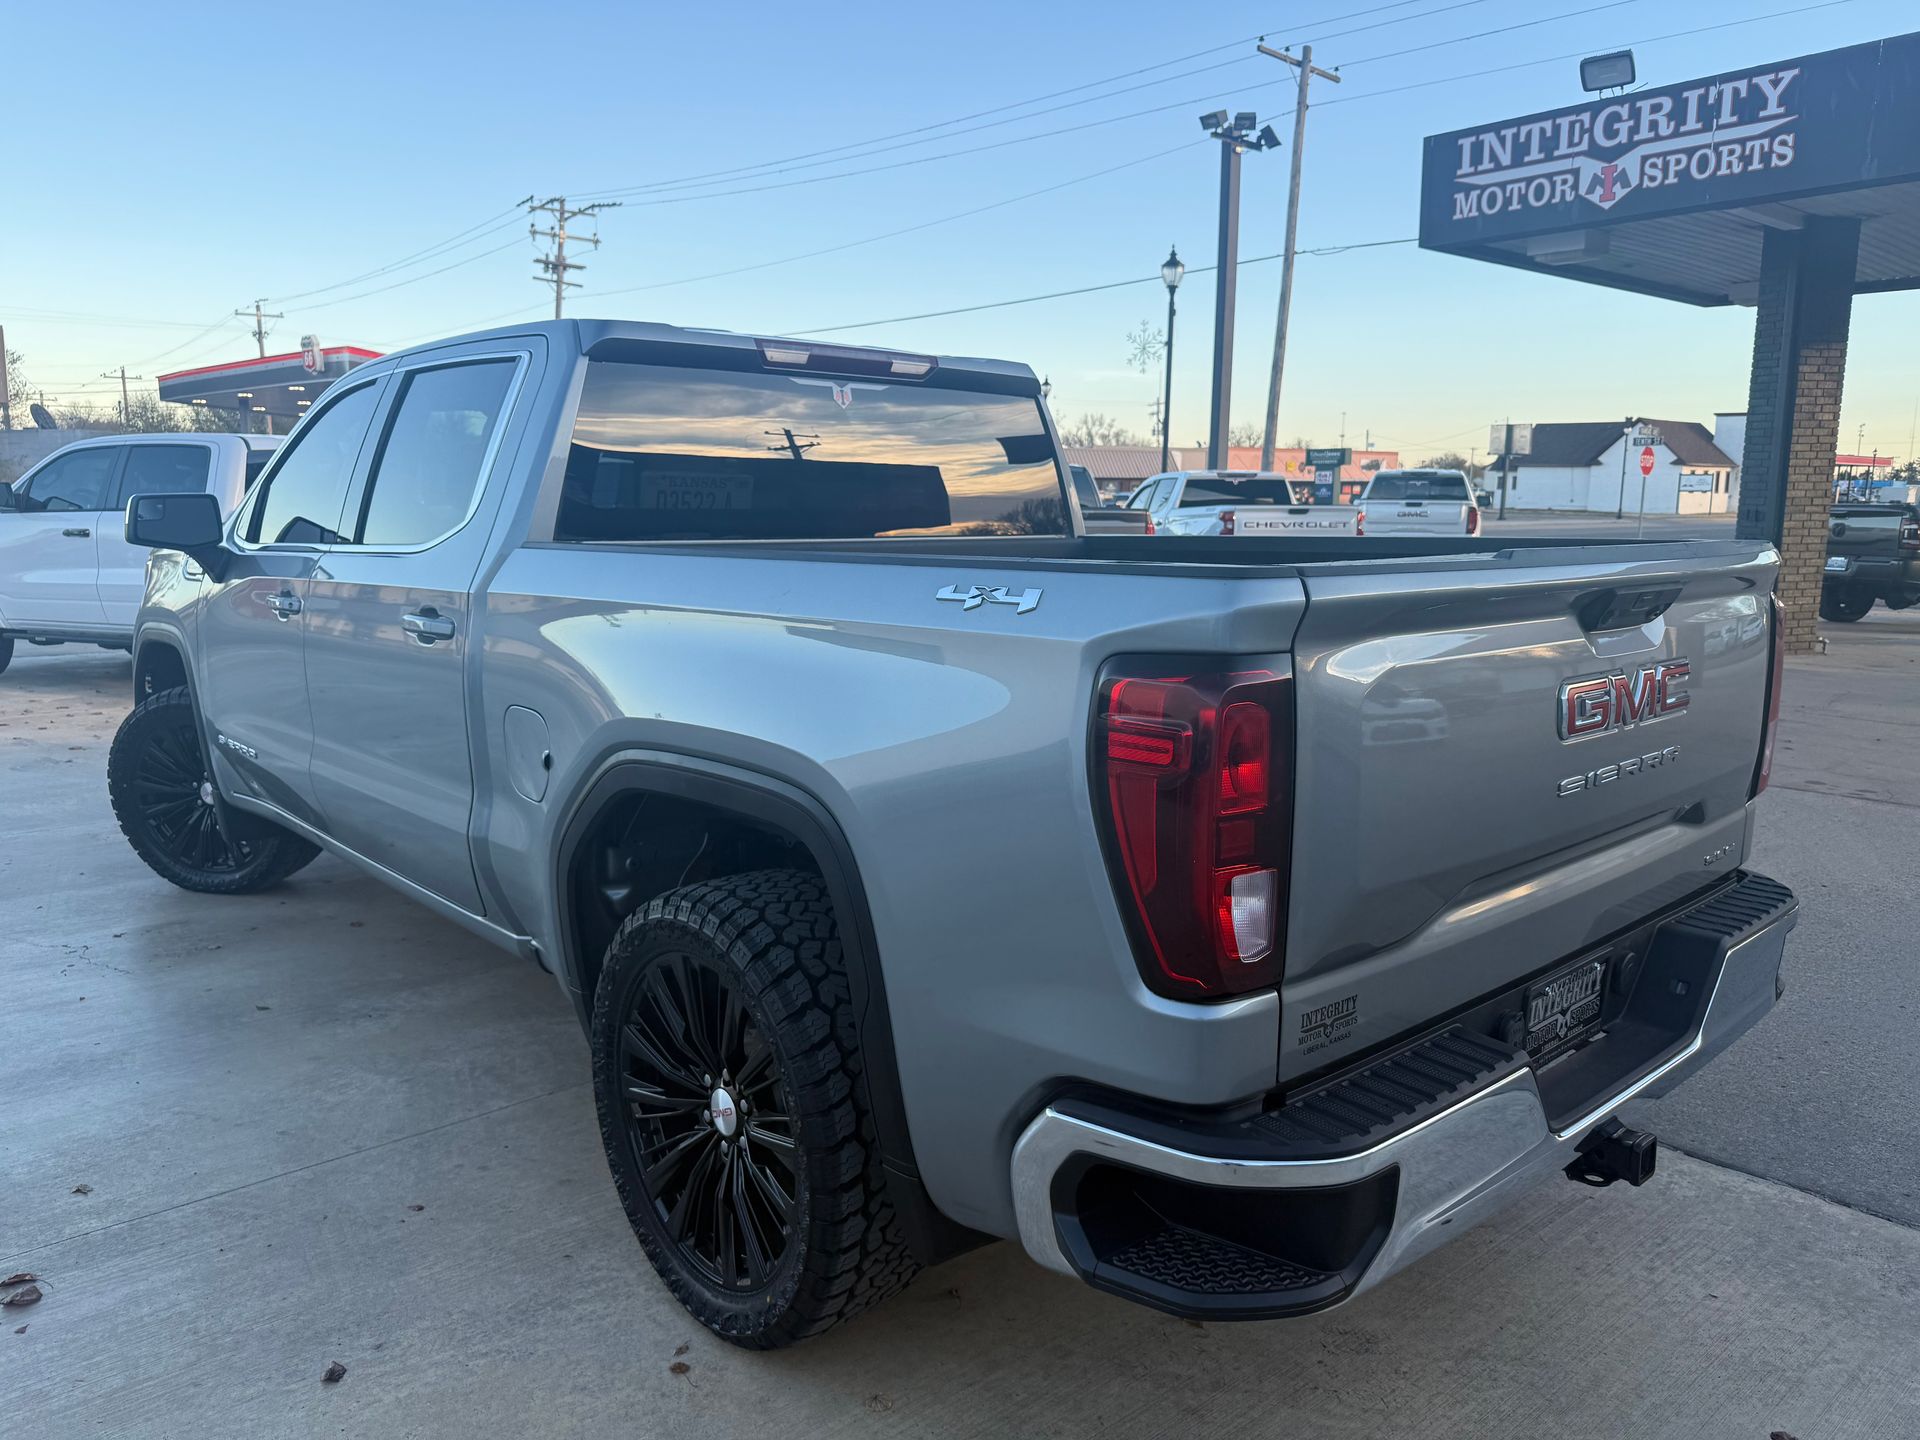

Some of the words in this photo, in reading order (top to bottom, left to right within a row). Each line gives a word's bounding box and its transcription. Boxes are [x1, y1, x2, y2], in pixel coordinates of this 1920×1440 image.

[1455, 68, 1800, 177] INTEGRITY
[1453, 173, 1576, 220] MOTOR
[1642, 133, 1796, 188] SPORTS
[1640, 455, 1654, 467] STOP
[668, 476, 728, 489] KANSAS
[1243, 521, 1349, 529] CHEVROLET
[1559, 659, 1690, 742] GMC
[1557, 745, 1680, 797] SIERRA
[1301, 994, 1358, 1029] INTEGRITY
[1528, 963, 1606, 1028] INTEGRITY
[1298, 1030, 1322, 1046] MOTOR
[1335, 1015, 1358, 1031] SPORTS
[1329, 1031, 1352, 1044] KANSAS
[1525, 1021, 1557, 1051] MOTOR
[1569, 996, 1601, 1027] SPORTS
[712, 1107, 732, 1118] GMC
